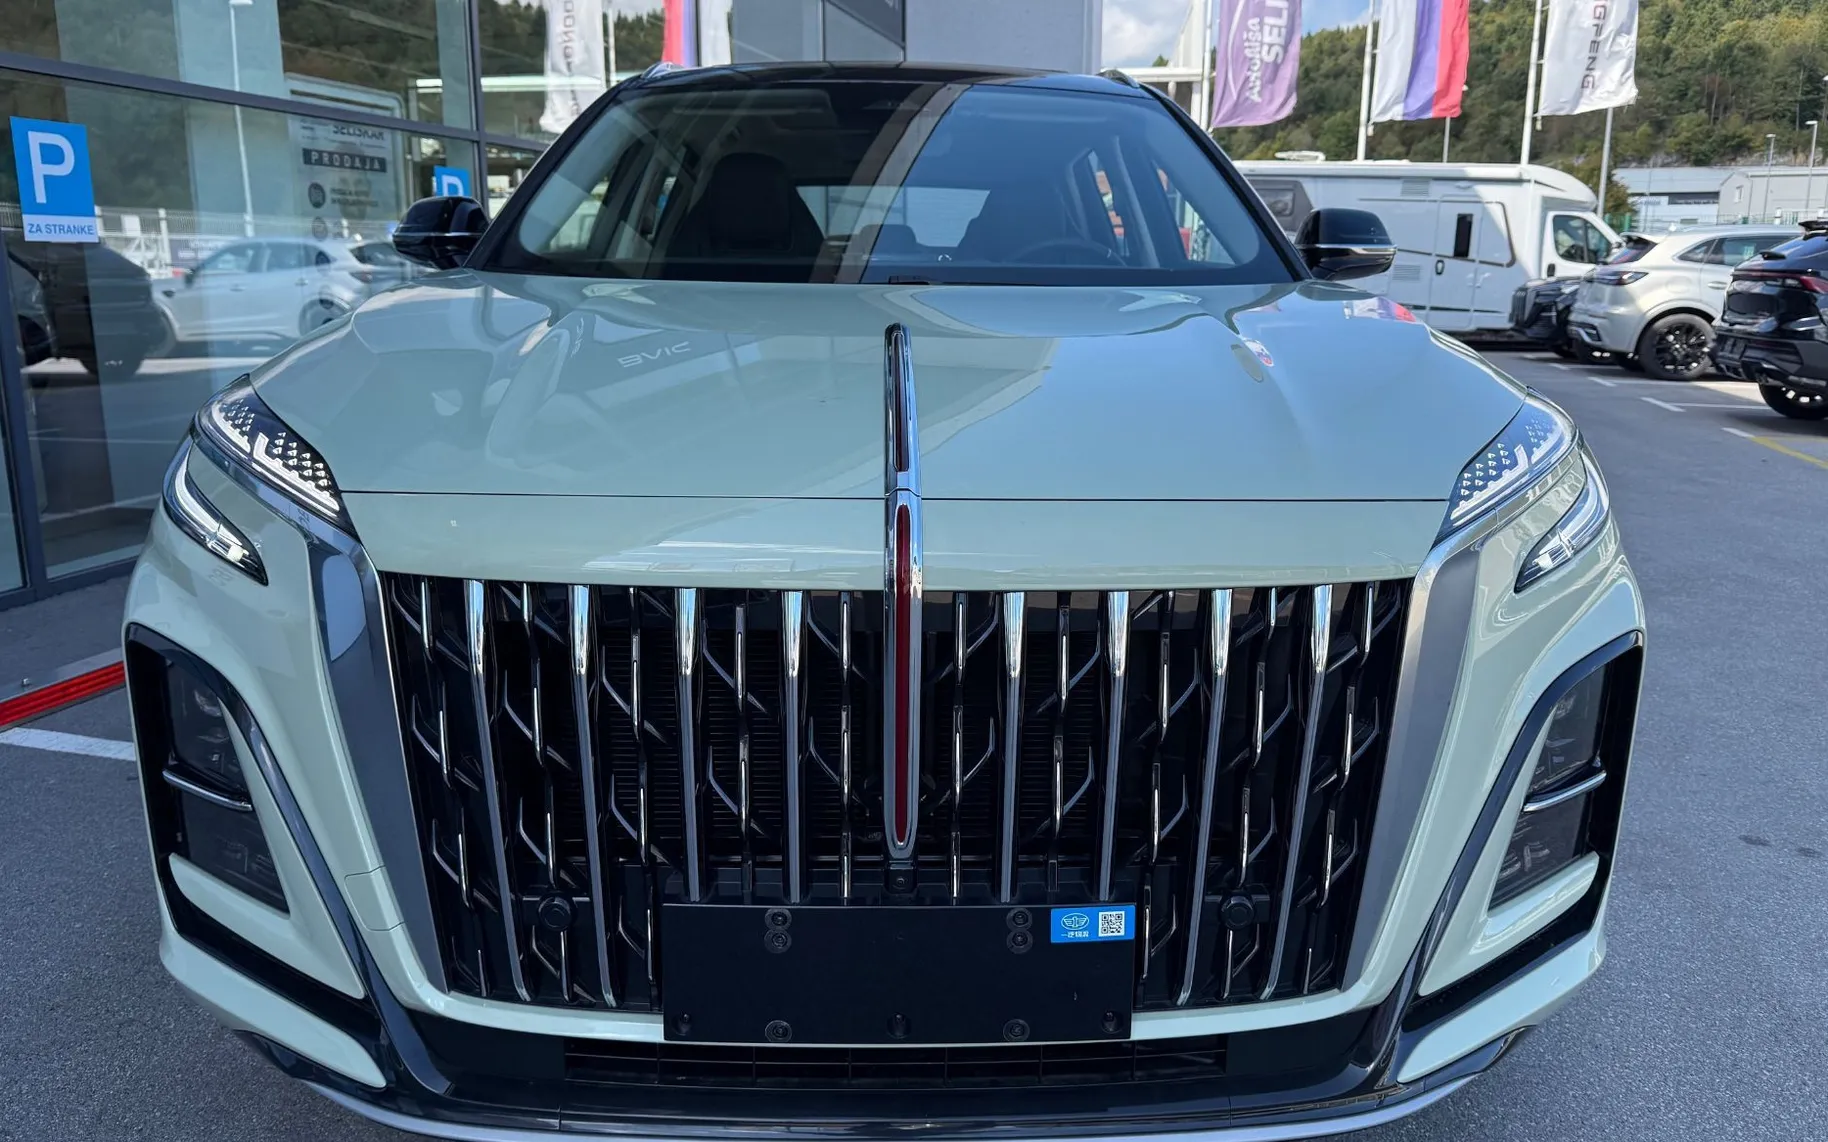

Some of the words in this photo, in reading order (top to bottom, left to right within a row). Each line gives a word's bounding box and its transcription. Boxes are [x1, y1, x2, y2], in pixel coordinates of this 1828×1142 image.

[27, 130, 75, 204] P
[310, 151, 381, 170] PRODAJA
[28, 223, 43, 234] ZA
[45, 223, 95, 236] STRANKE
